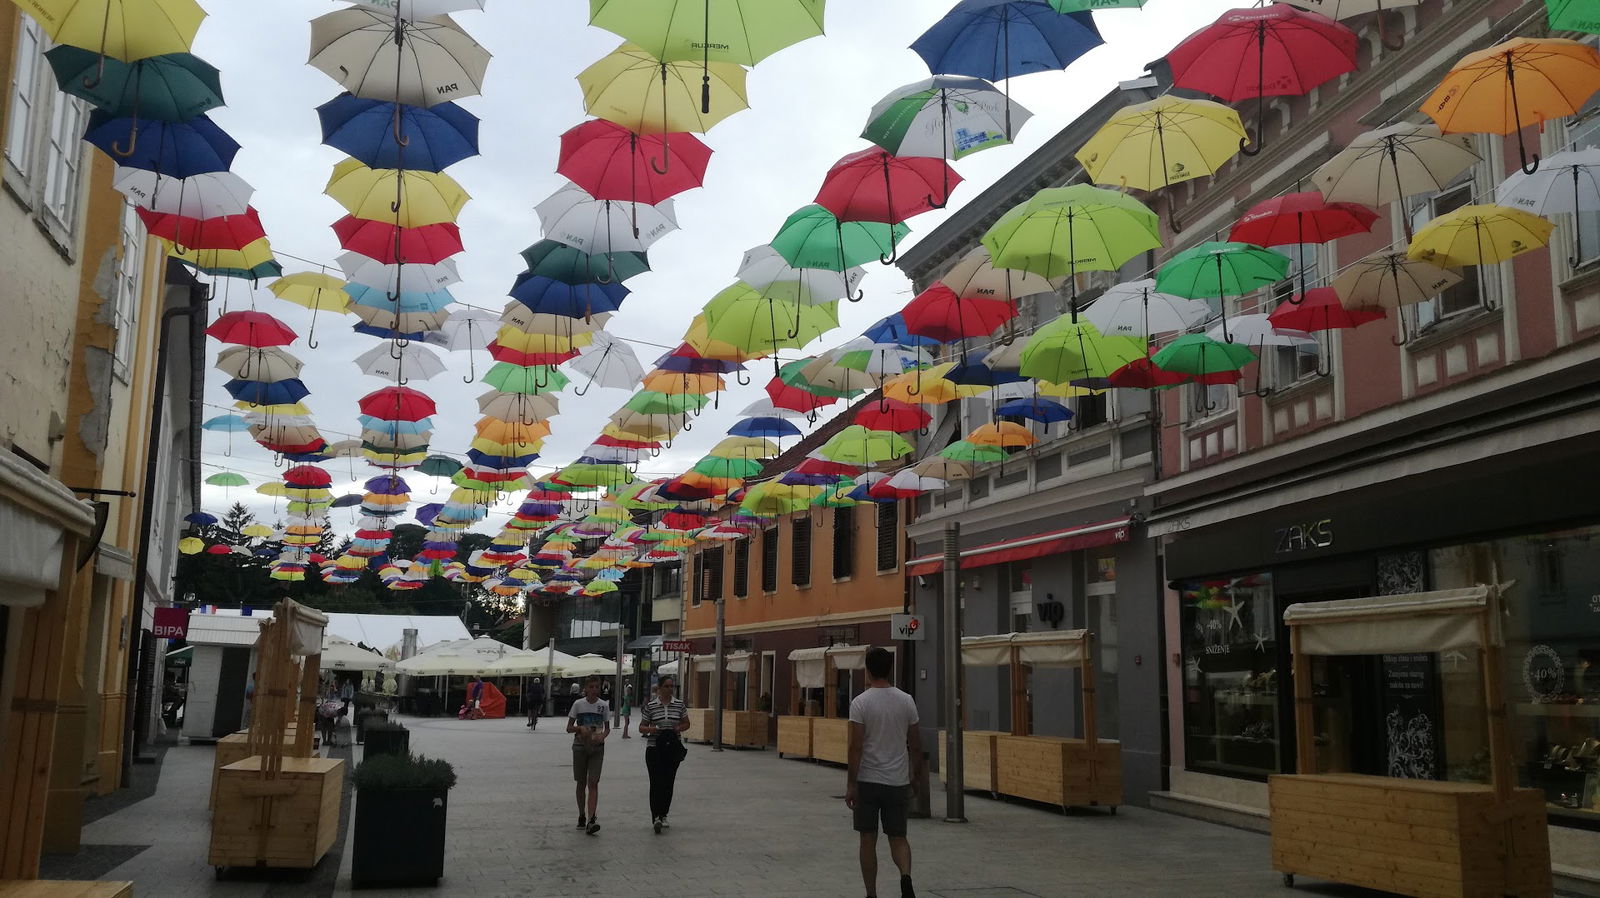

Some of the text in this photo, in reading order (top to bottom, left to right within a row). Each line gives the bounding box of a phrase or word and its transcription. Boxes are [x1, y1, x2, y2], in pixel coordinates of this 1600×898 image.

[1275, 518, 1333, 553] ZAKS
[1037, 593, 1064, 629] vip
[154, 625, 184, 638] BIPA
[899, 623, 915, 638] vip
[665, 641, 691, 651] TISAK
